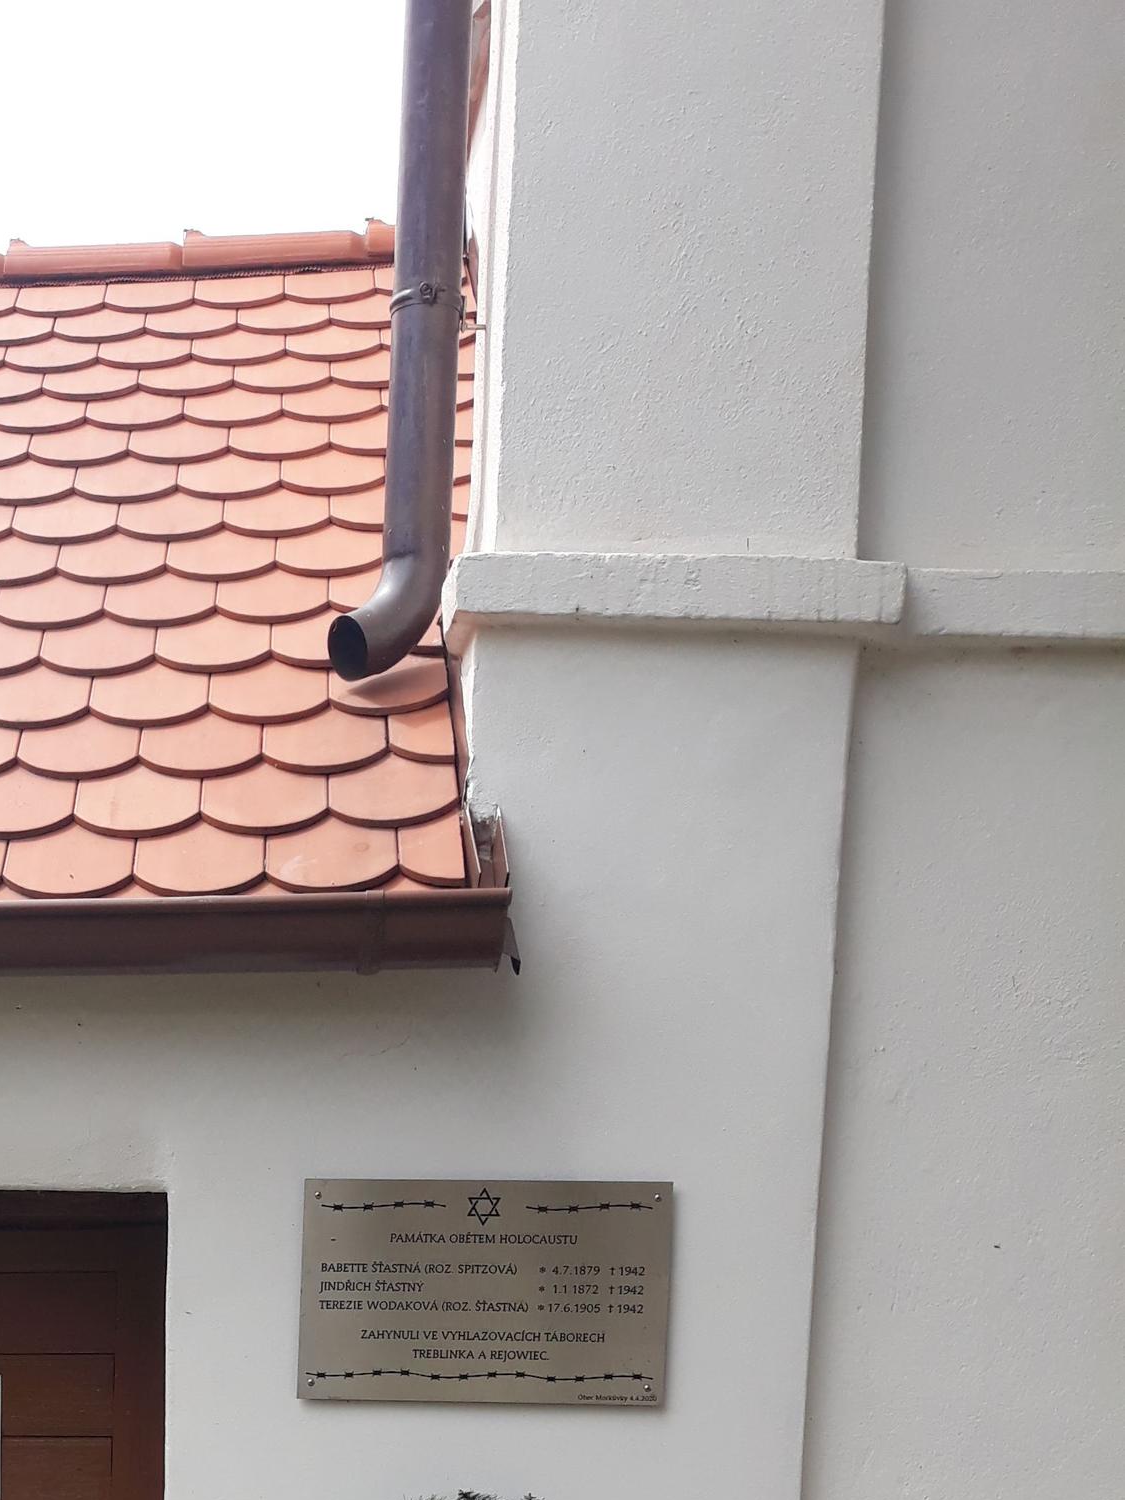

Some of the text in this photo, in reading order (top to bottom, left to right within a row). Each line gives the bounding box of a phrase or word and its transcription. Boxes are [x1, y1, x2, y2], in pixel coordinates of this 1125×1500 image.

[389, 1231, 579, 1246] PAMÁTKA OBĚTEM HOLOCAUSTU
[321, 1262, 368, 1273] BABETTE
[371, 1261, 421, 1274] ŠŤASTNÁ
[425, 1264, 454, 1275] (ROZ.
[458, 1262, 518, 1275] SPITZOVÁ)
[551, 1265, 601, 1276] 4.7.1879
[319, 1280, 371, 1294] JINDŘICH
[374, 1279, 424, 1293] ŠŤASTNÝ
[319, 1300, 364, 1310] TEREZIE
[367, 1299, 439, 1312] WODAKOVÁ
[441, 1301, 471, 1313] (ROZ.
[547, 1303, 601, 1314] 17.6.1905
[360, 1329, 606, 1343] ZAHYNULI VE VYHLAZOVACÍCH TÁBORECH
[412, 1348, 550, 1362] TREBLINKA A REJOWIEC.
